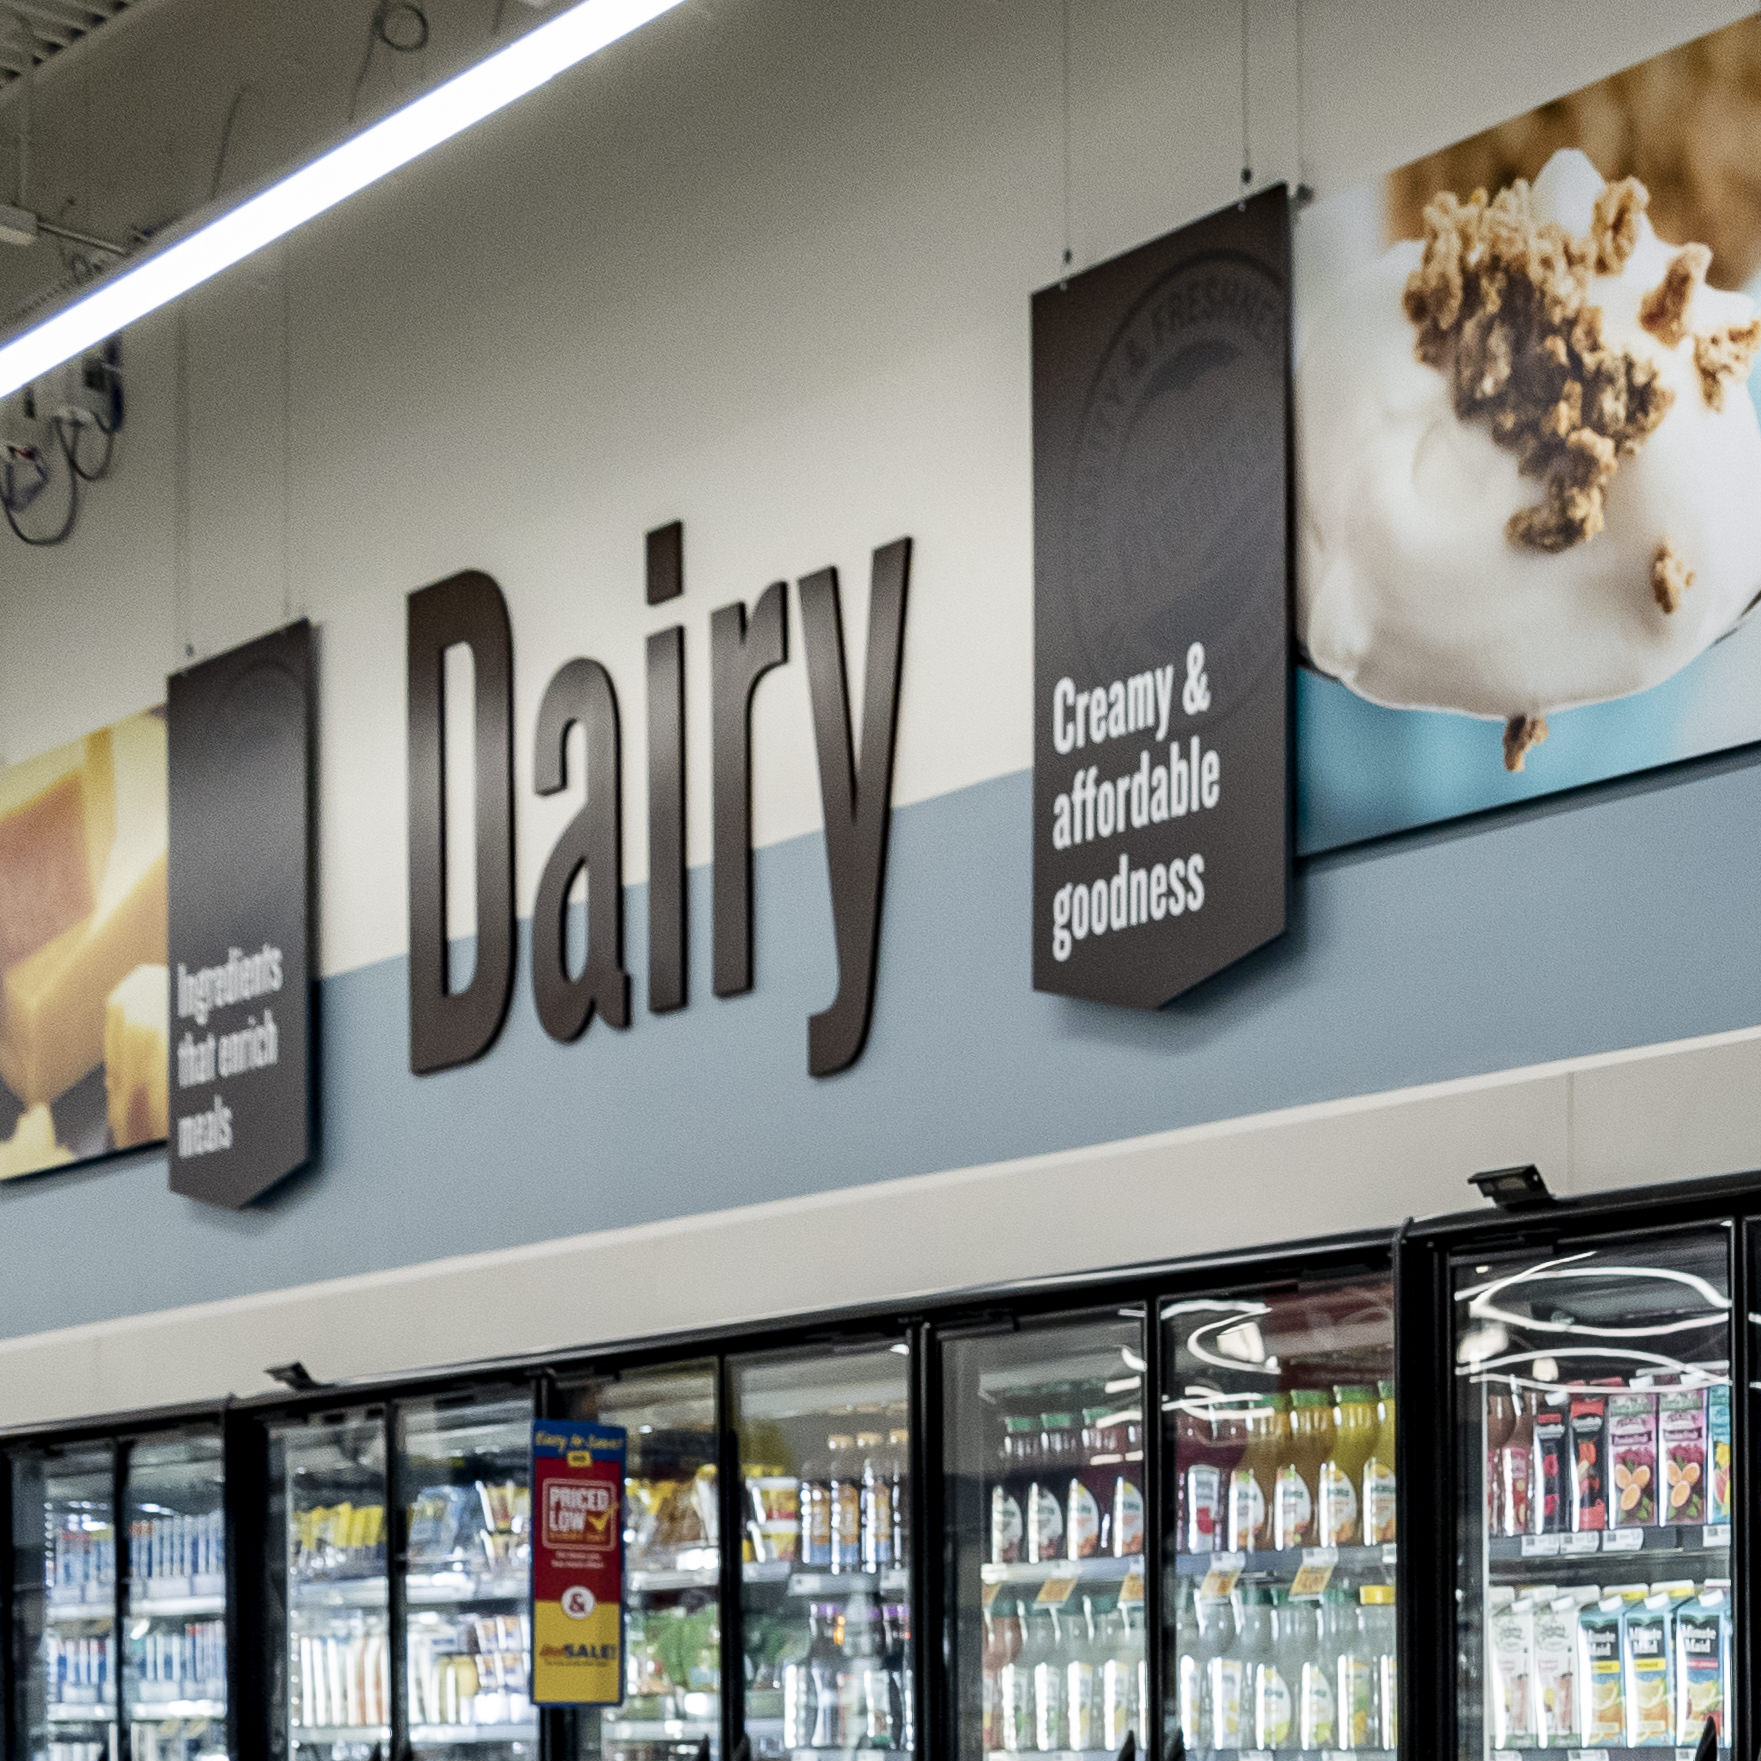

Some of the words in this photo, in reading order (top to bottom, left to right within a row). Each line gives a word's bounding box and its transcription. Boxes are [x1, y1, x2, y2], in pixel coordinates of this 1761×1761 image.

[1053, 672, 1175, 755] Creamy
[1182, 641, 1211, 716] &
[406, 519, 914, 1080] Dairy
[1052, 734, 1220, 851] affordable
[1052, 853, 1204, 962] goodness
[177, 1031, 215, 1088] that
[218, 1009, 278, 1078] enrich
[178, 1094, 233, 1159] meals
[549, 1510, 586, 1532] LOW
[550, 1487, 609, 1511] PRICED
[569, 1592, 586, 1613] &
